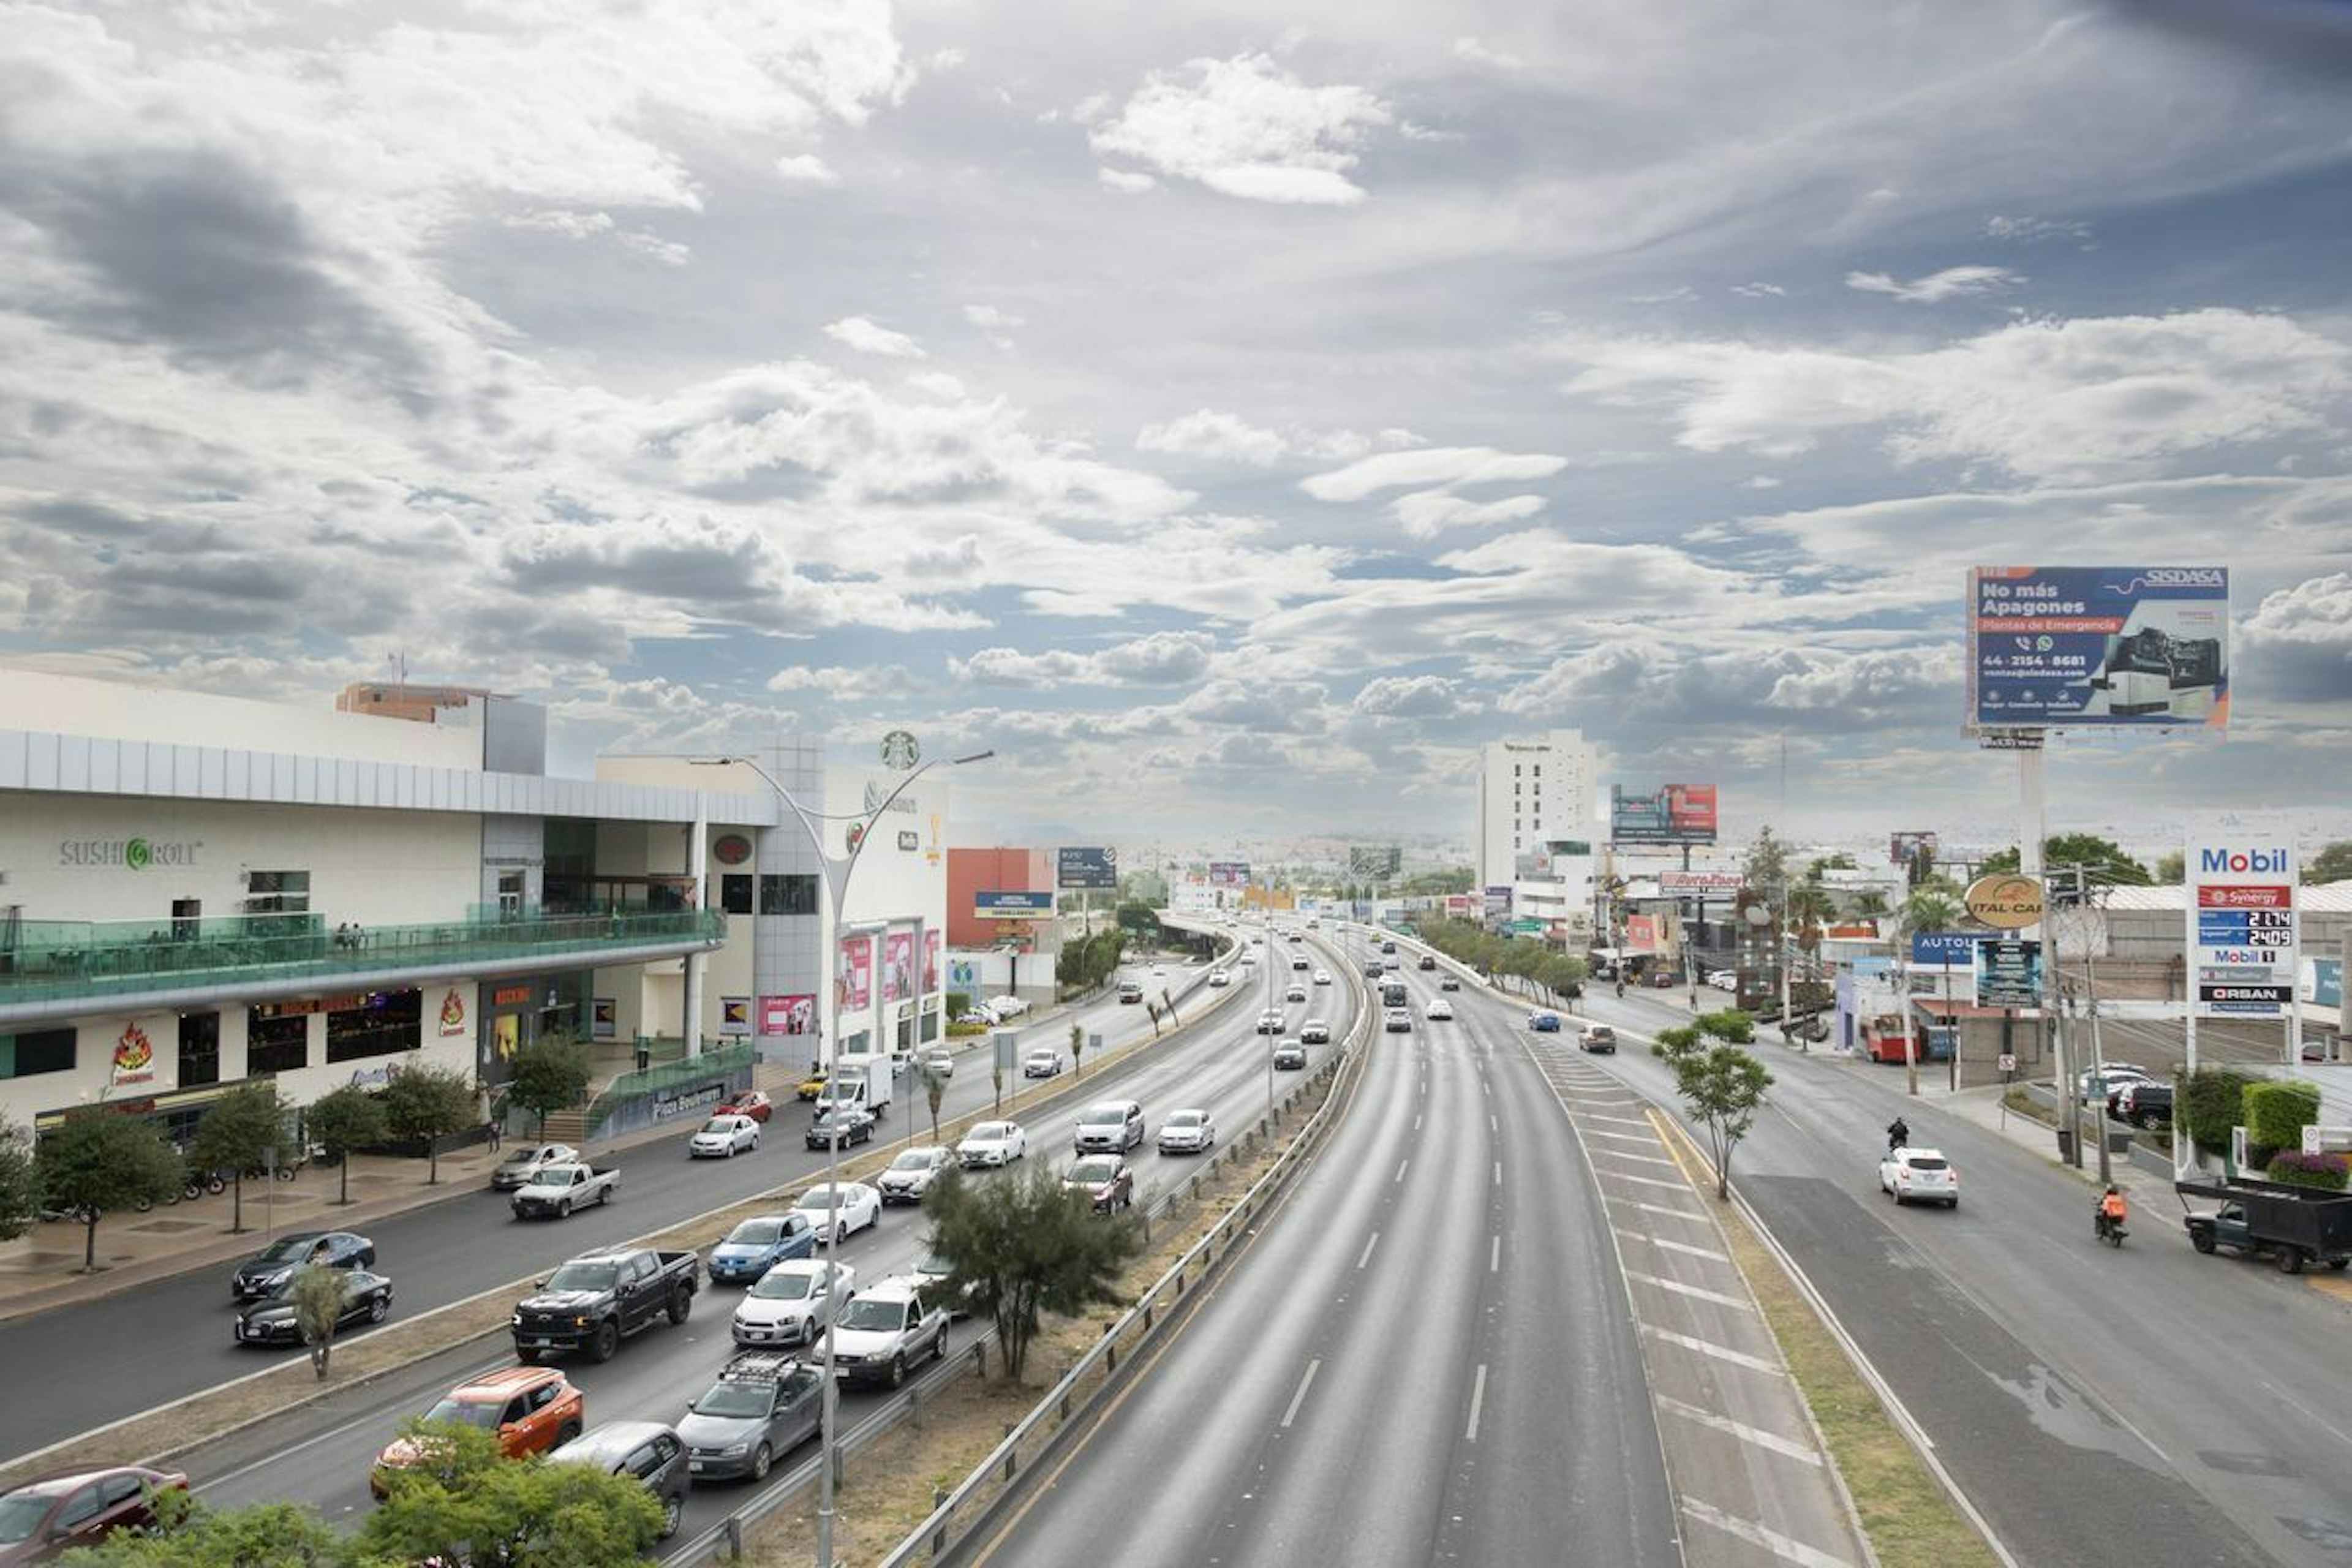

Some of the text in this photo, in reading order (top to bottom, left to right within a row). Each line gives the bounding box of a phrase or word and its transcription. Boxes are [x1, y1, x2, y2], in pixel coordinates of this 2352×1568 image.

[2147, 570, 2223, 582] SISDASA
[1982, 581, 2058, 597] No más
[1982, 599, 2086, 616] Apagones
[61, 840, 124, 865] SUSHI
[2202, 848, 2286, 872] Mobil
[2229, 889, 2278, 905] Synergy
[2215, 951, 2259, 962] Mobil
